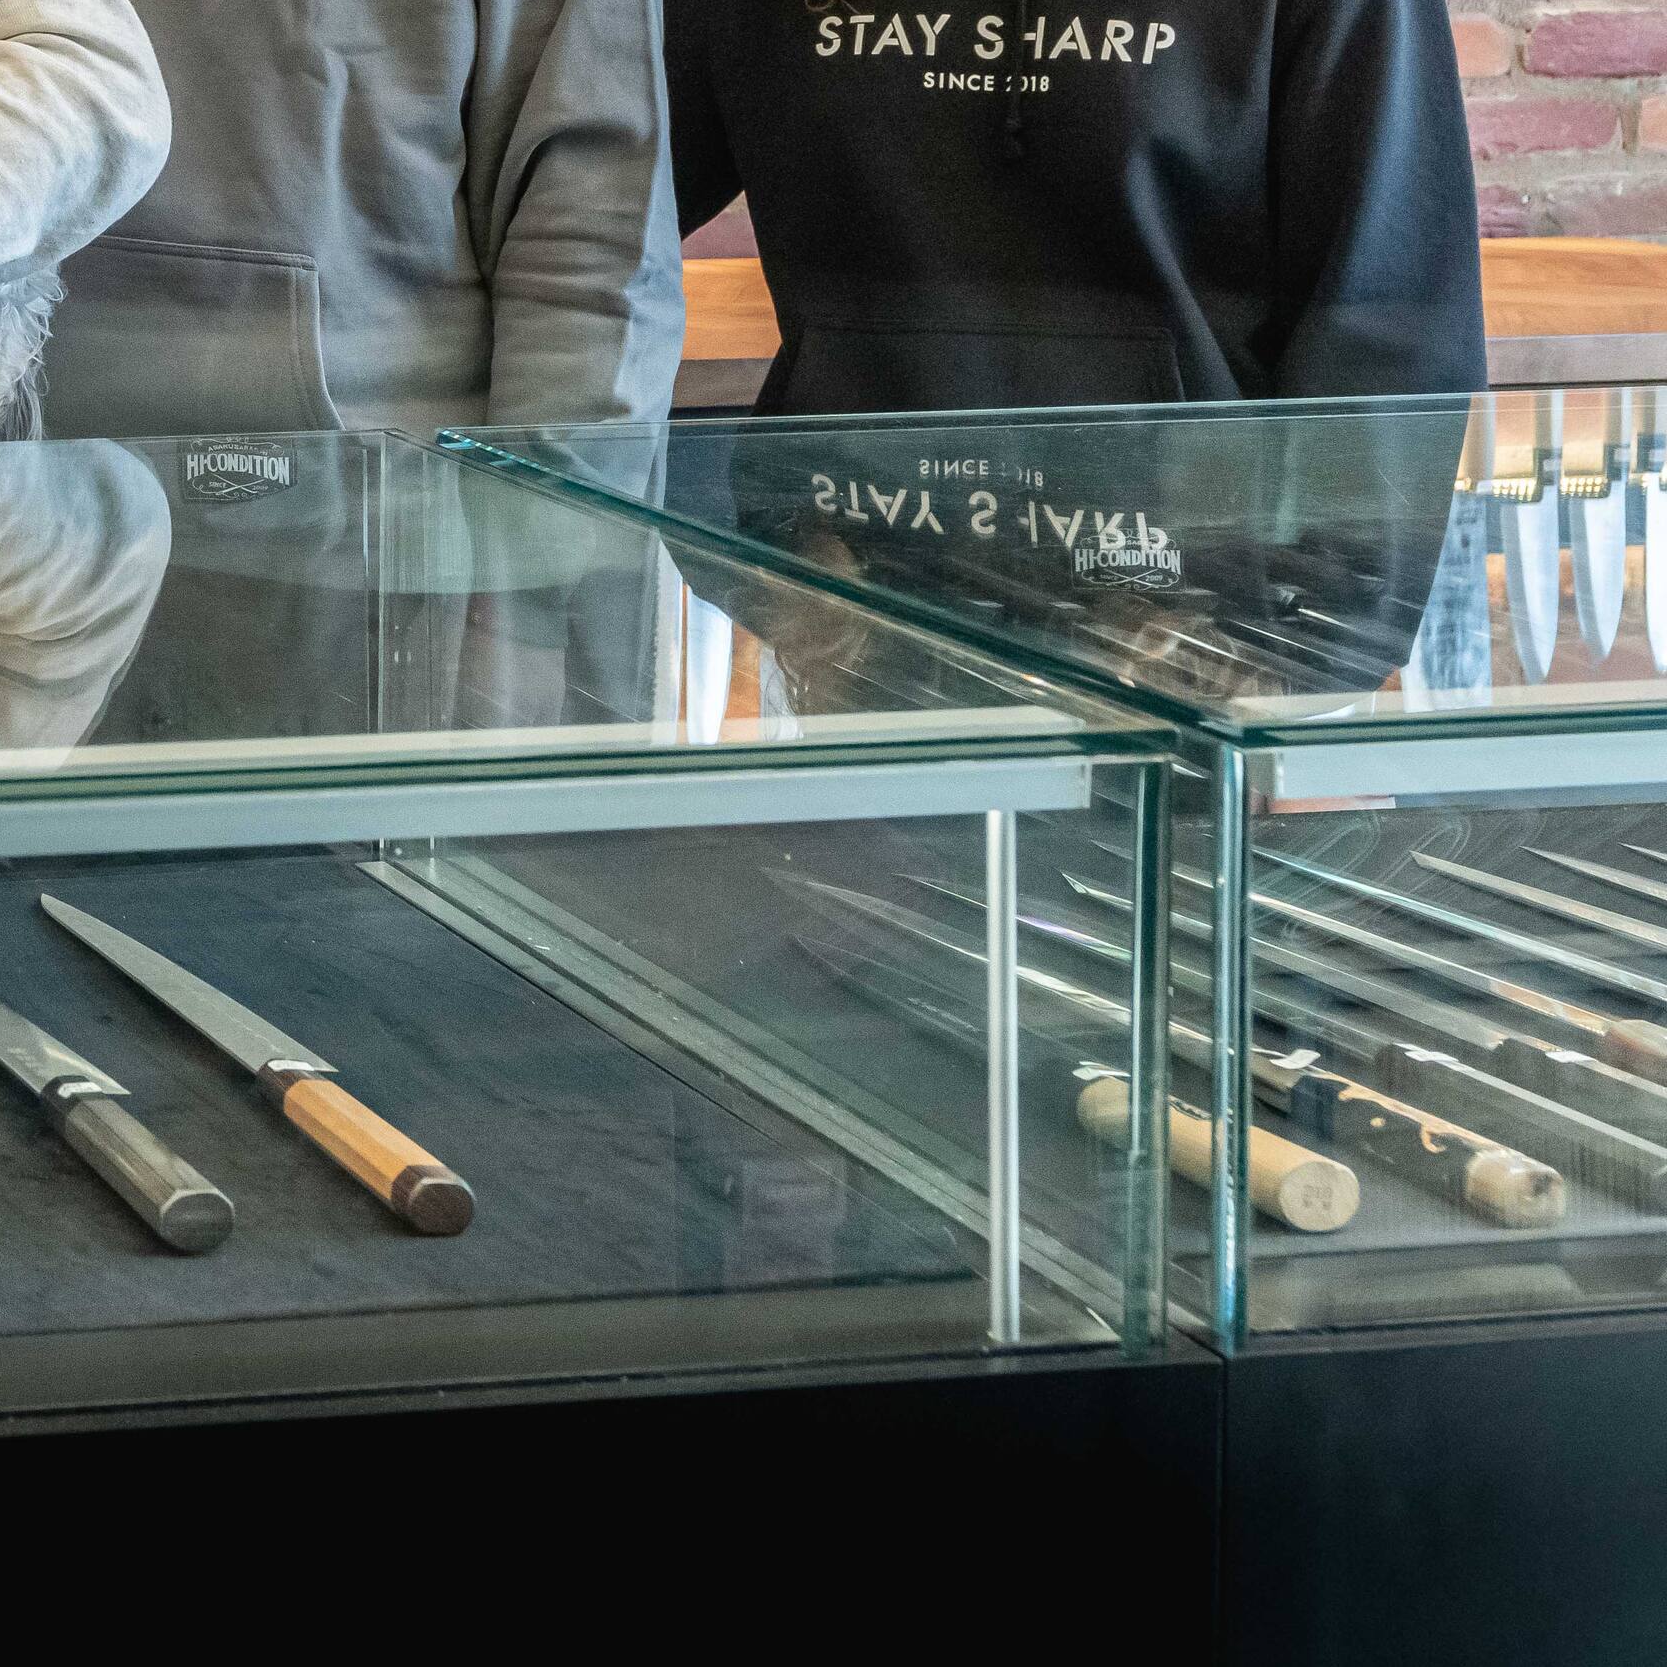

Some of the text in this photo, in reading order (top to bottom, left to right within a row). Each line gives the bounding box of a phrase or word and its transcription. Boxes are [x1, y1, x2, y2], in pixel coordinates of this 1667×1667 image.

[815, 12, 951, 57] STAY
[923, 71, 1050, 92] SINCE 18
[187, 453, 290, 487] HI-CONDITION
[1074, 548, 1182, 575] HI-CONDITION
